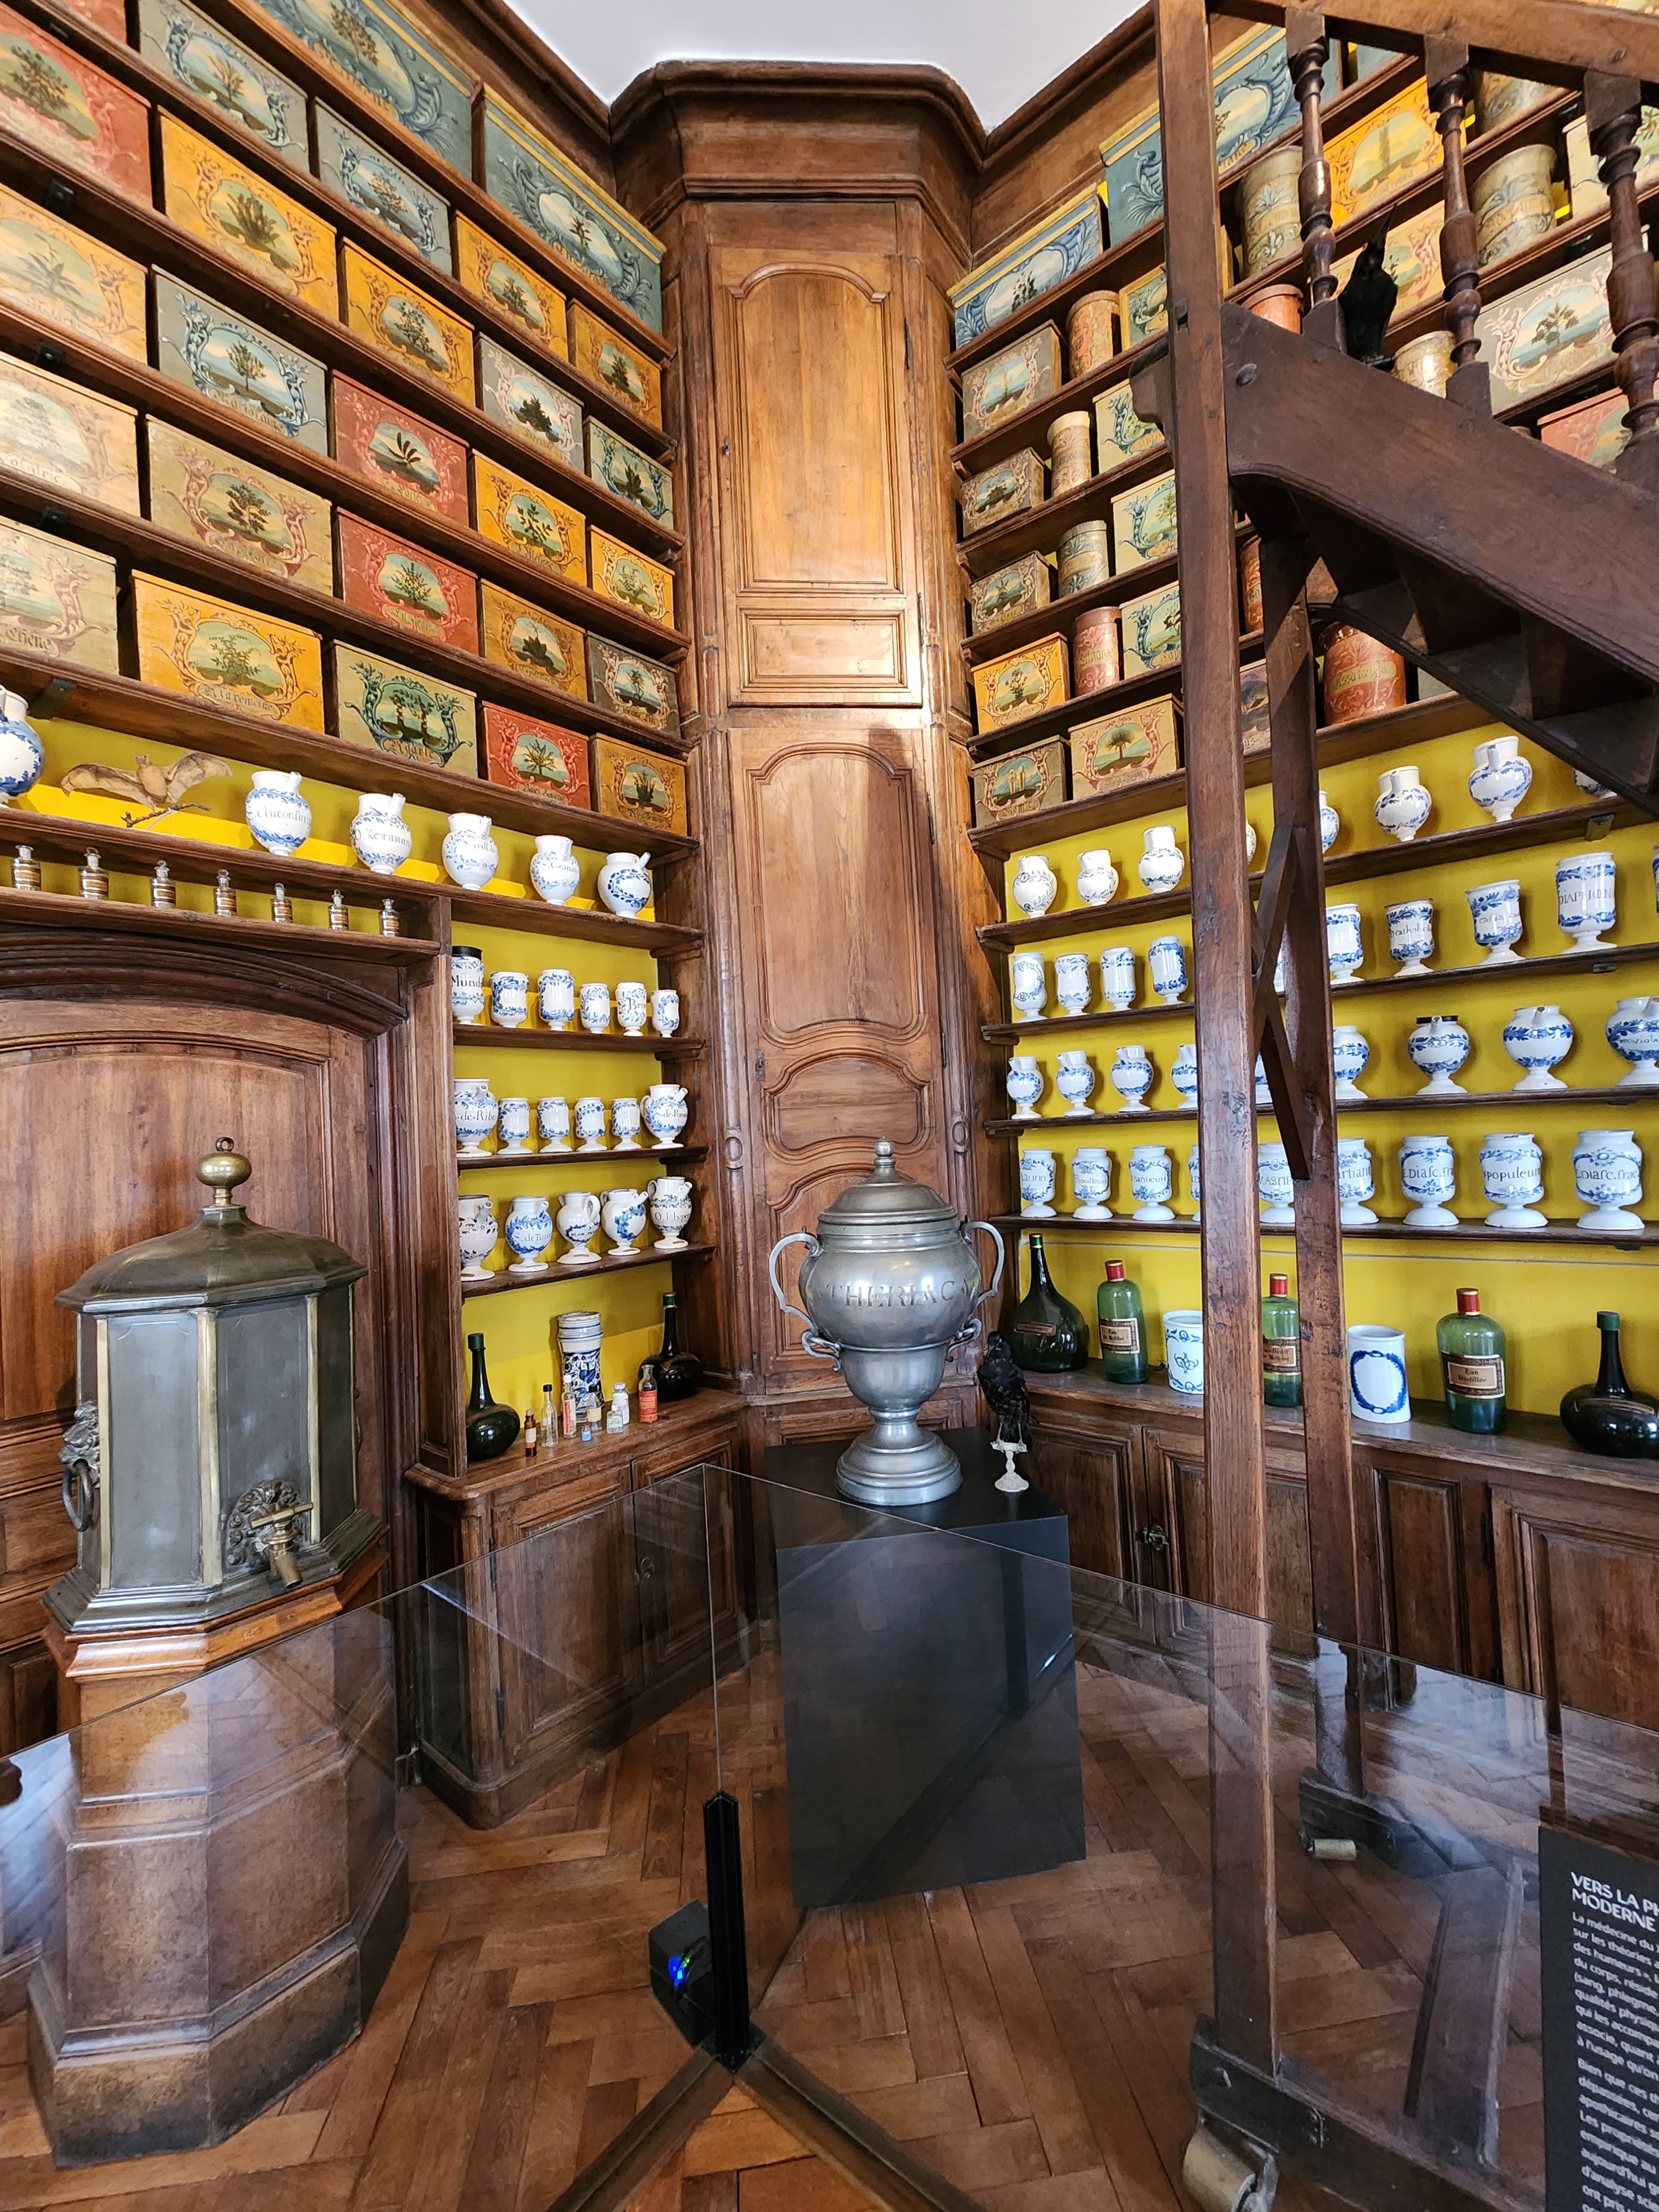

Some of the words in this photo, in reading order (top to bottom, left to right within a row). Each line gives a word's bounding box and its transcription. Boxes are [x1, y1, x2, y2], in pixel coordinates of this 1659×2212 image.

[1571, 1871, 1613, 1899] VERS
[1616, 1888, 1640, 1910] LA
[1572, 1888, 1656, 1932] MODERNE
